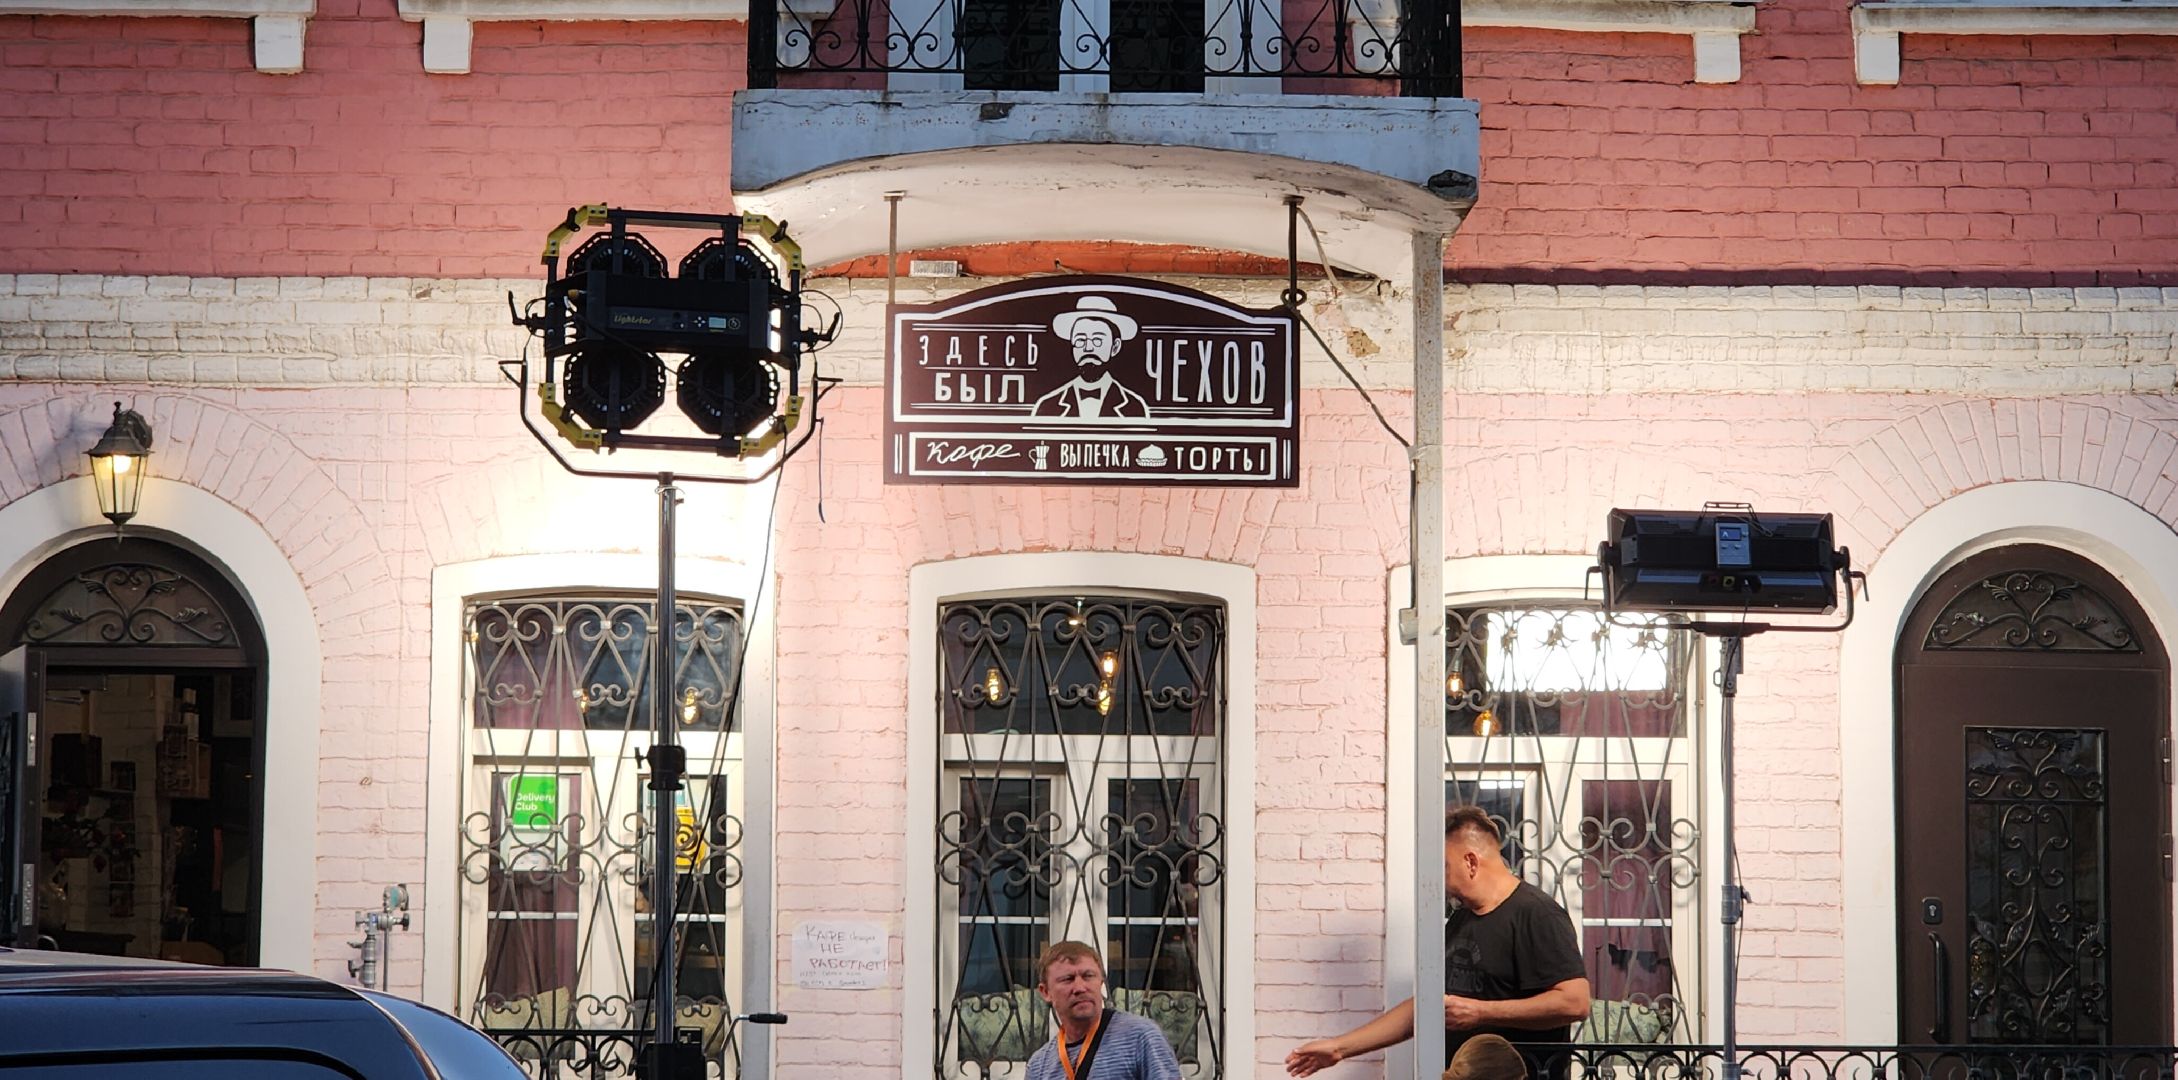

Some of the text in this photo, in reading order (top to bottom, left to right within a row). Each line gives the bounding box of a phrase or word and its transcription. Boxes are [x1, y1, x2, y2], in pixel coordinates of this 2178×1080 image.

[918, 333, 1039, 367] ЗДЕСЬ
[1145, 338, 1267, 404] ЧЕХОВ
[934, 372, 1026, 403] БЫЛ
[926, 441, 1266, 472] Кофе ВЫПЕЧКА ТОРТЫ
[515, 802, 538, 811] Club
[516, 792, 555, 804] Delivery
[820, 943, 845, 954] НЕ
